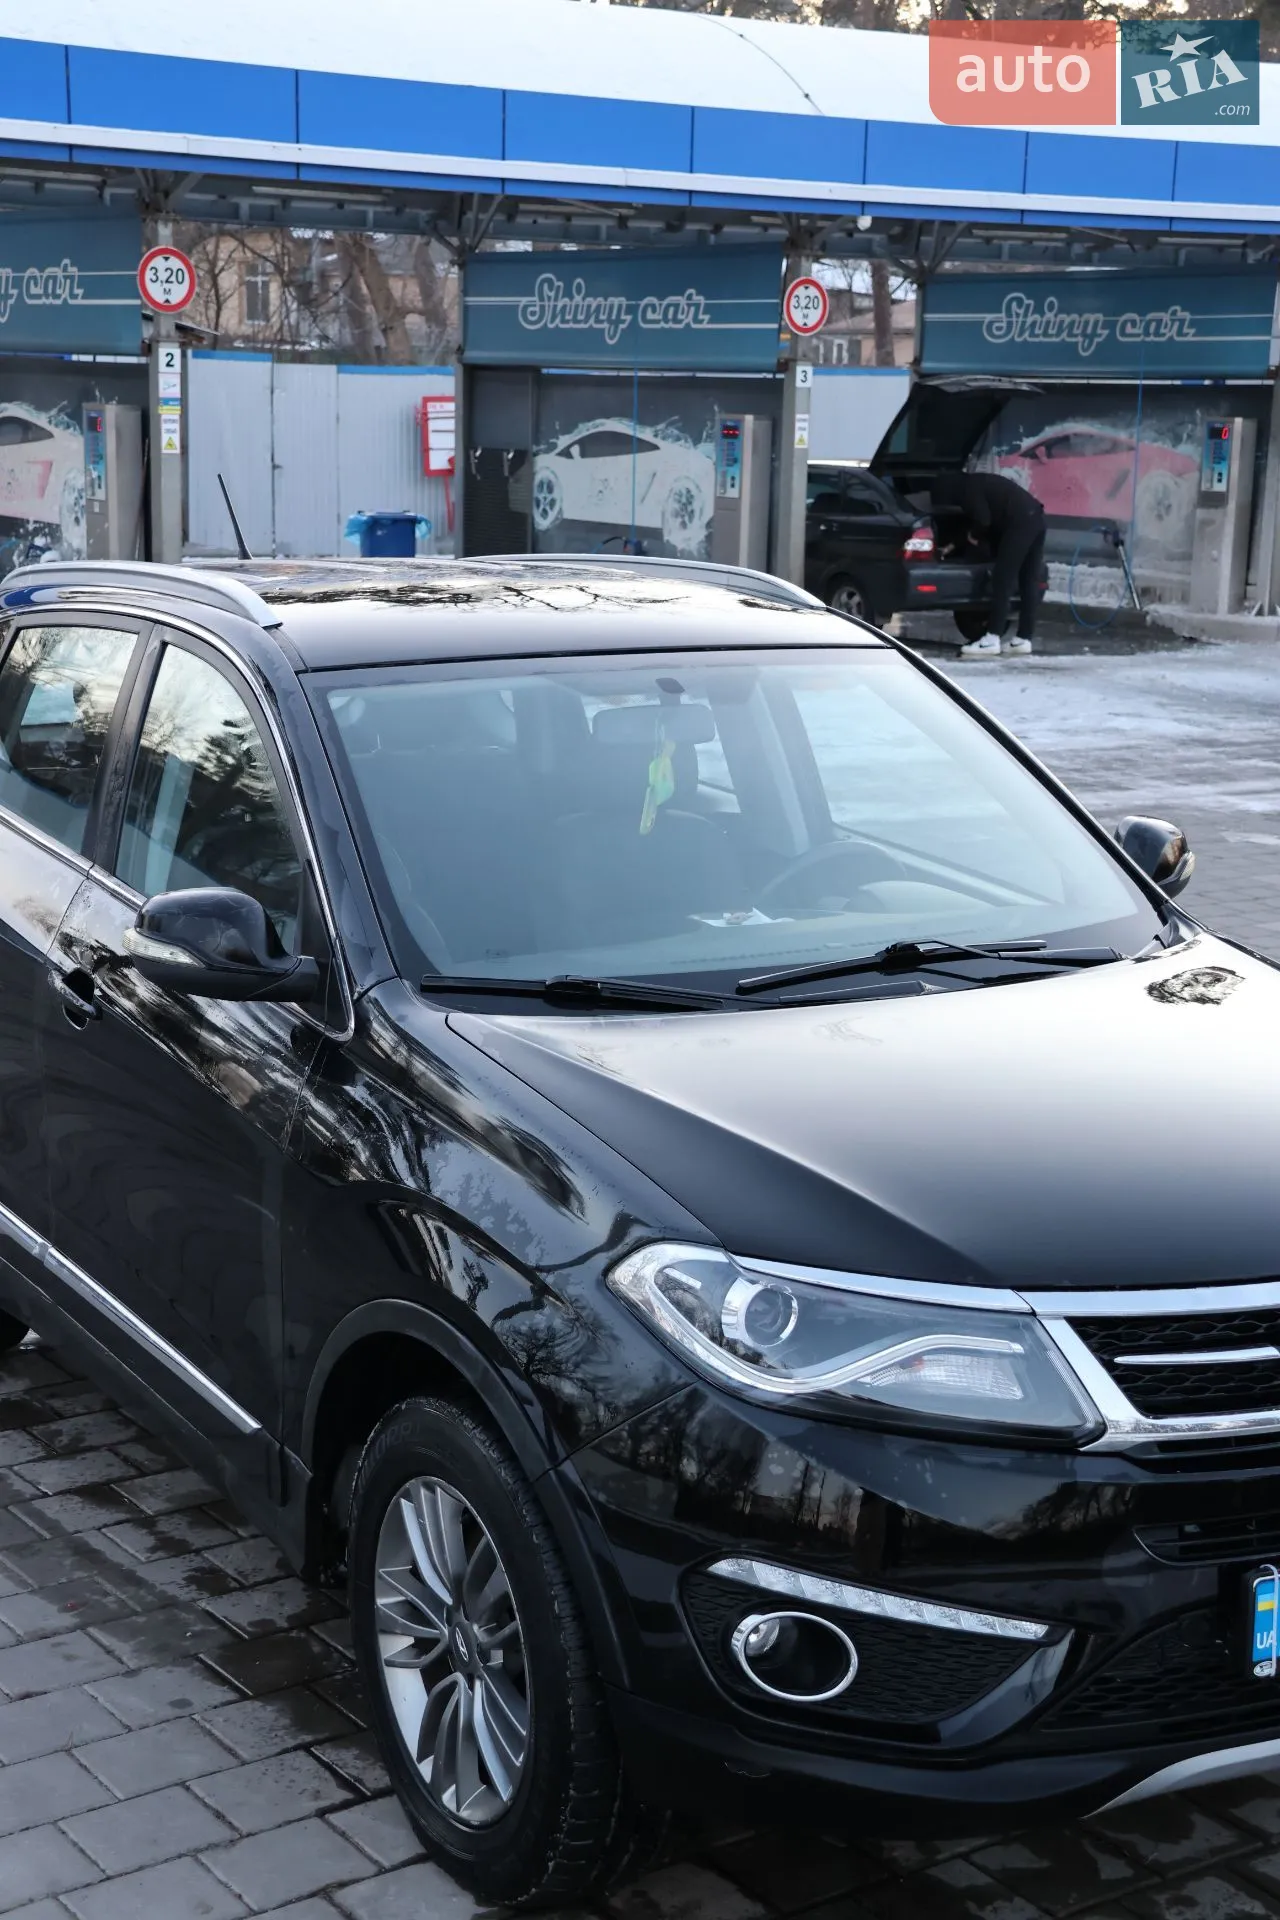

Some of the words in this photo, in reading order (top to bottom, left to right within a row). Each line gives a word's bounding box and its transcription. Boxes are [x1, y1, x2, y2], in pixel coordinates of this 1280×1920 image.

[23, 258, 84, 305] car
[149, 266, 185, 287] 3,20
[518, 273, 633, 345] Shiny
[638, 288, 711, 329] car
[982, 292, 1110, 356] Shiny
[1116, 305, 1196, 341] car
[165, 352, 175, 368] 2
[800, 370, 808, 383] 3
